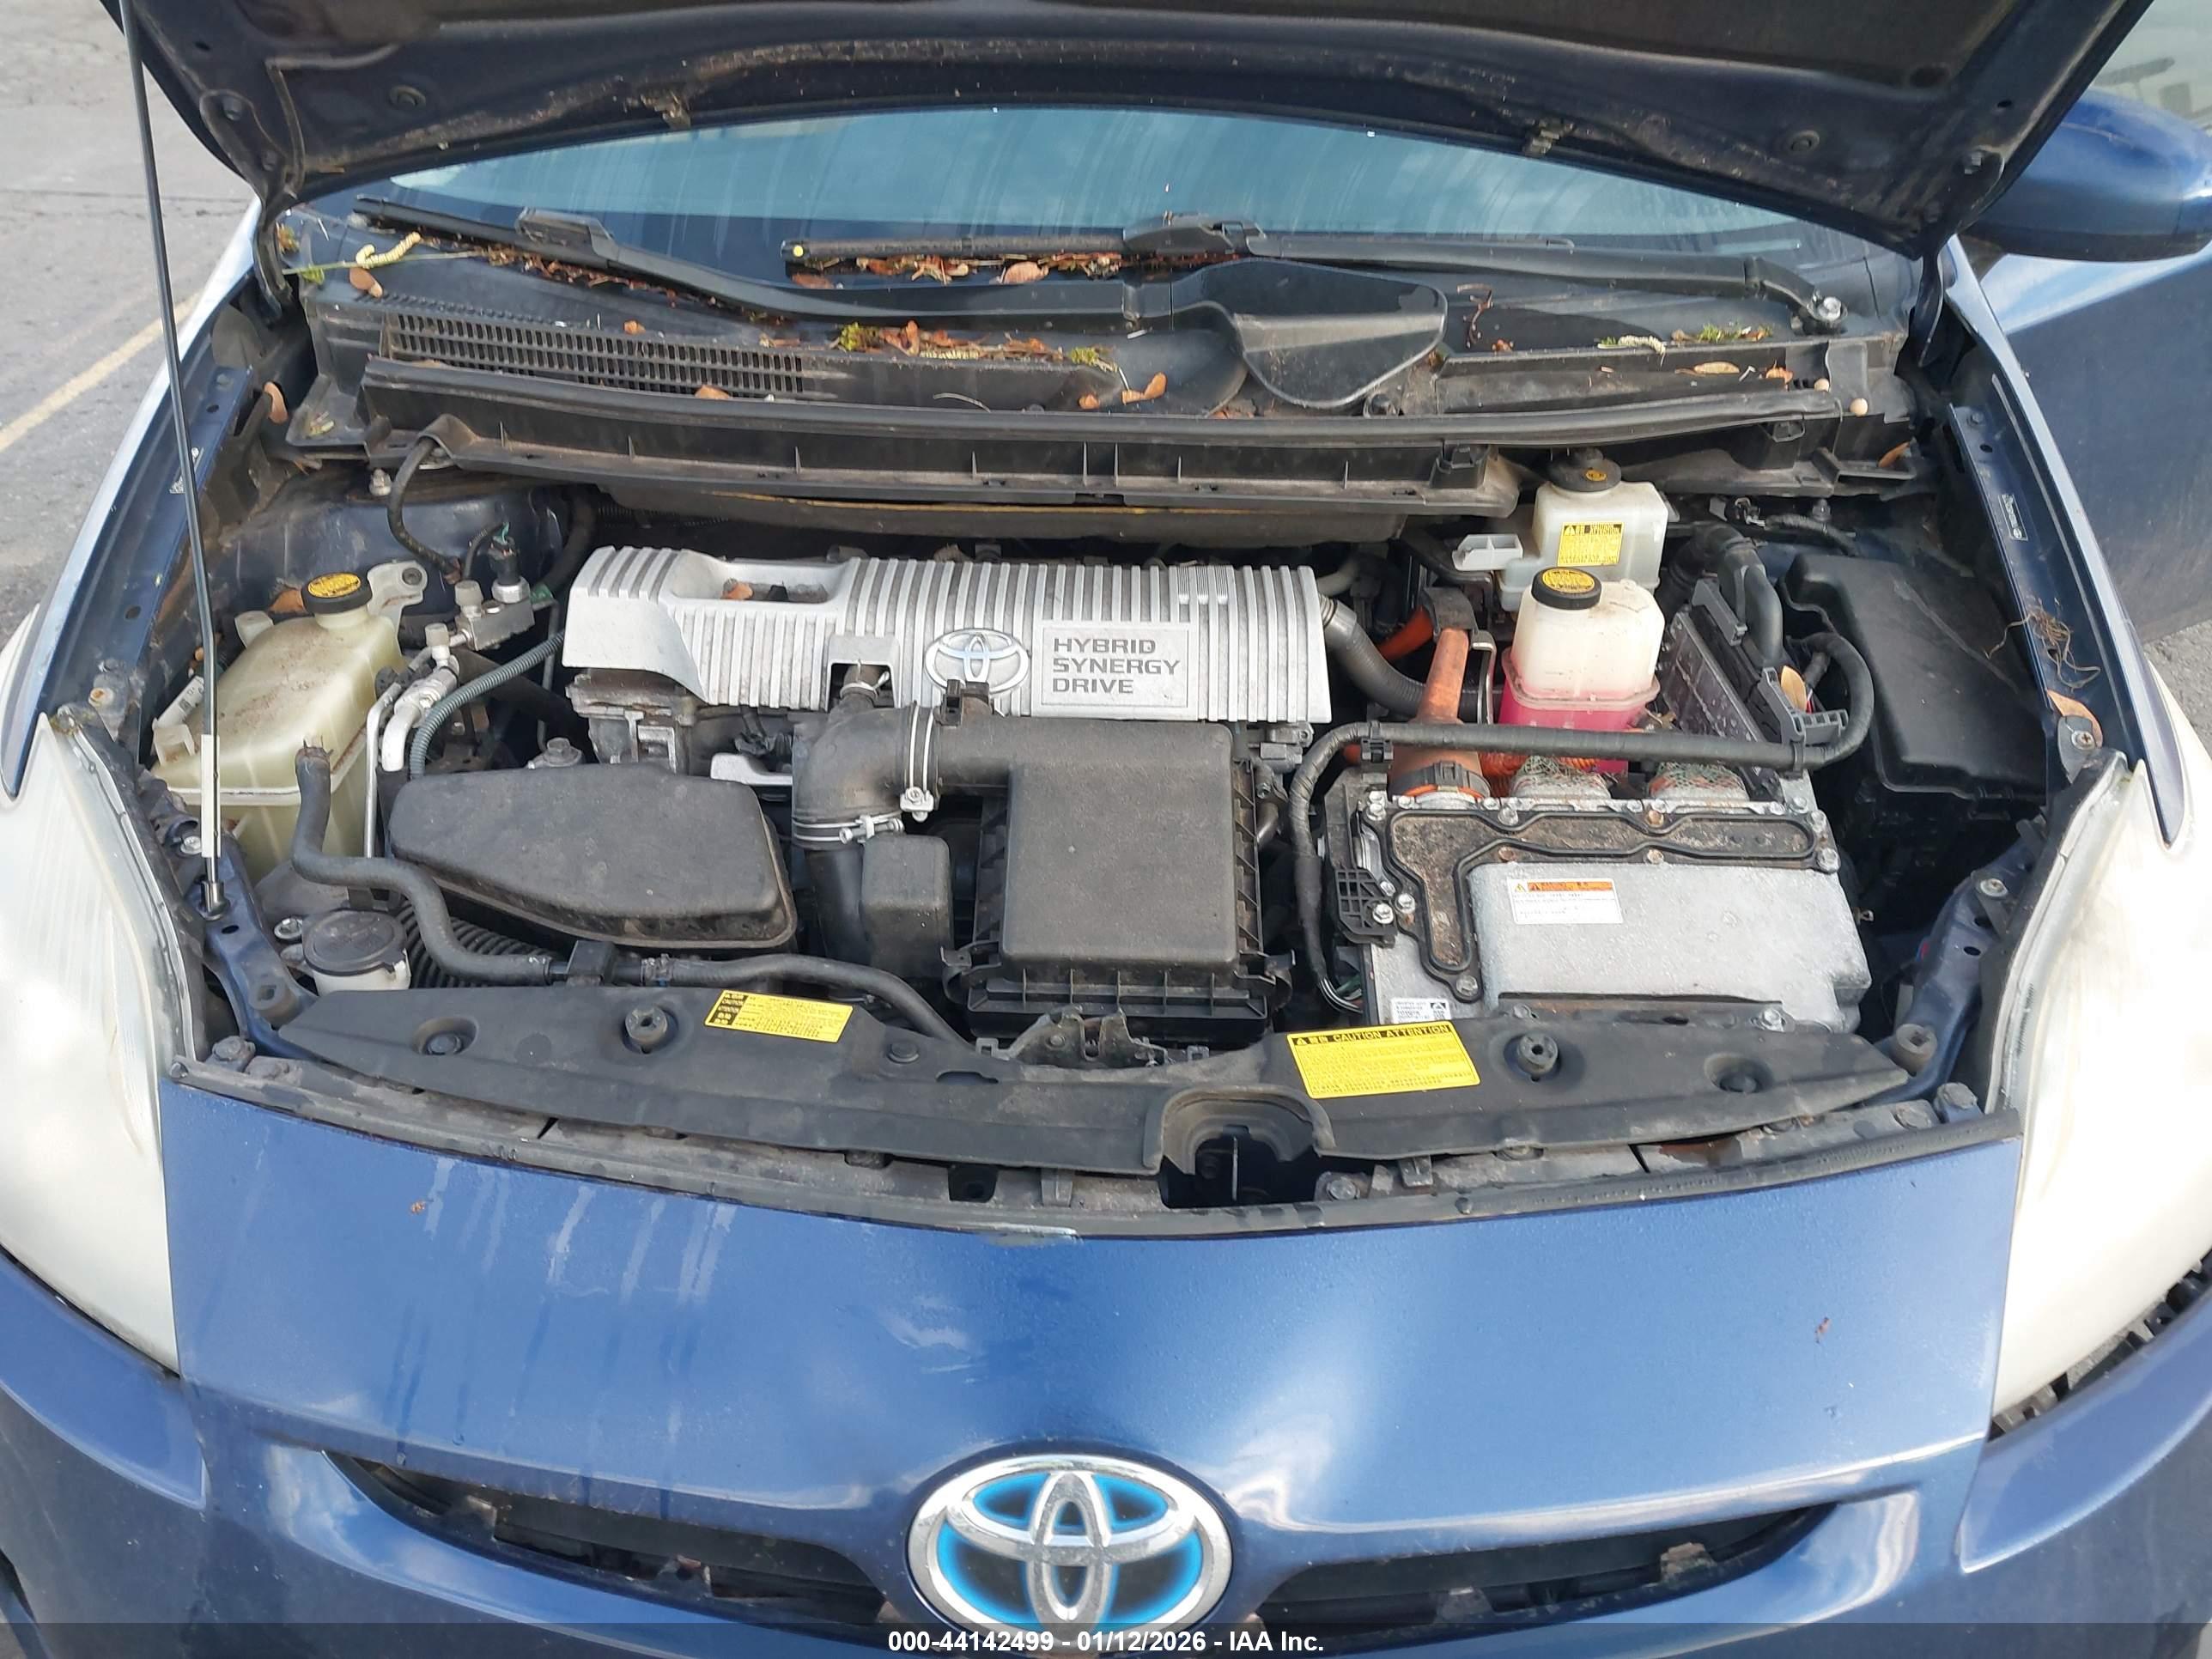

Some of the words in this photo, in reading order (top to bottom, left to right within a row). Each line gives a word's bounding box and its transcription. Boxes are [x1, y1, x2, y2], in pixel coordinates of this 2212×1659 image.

[1054, 638, 1156, 654] HYBRID
[1053, 658, 1181, 675] SYNERGY
[1053, 678, 1133, 694] DRIVE
[1333, 1032, 1382, 1042] CAUTION
[1386, 1024, 1449, 1038] ATTENTION
